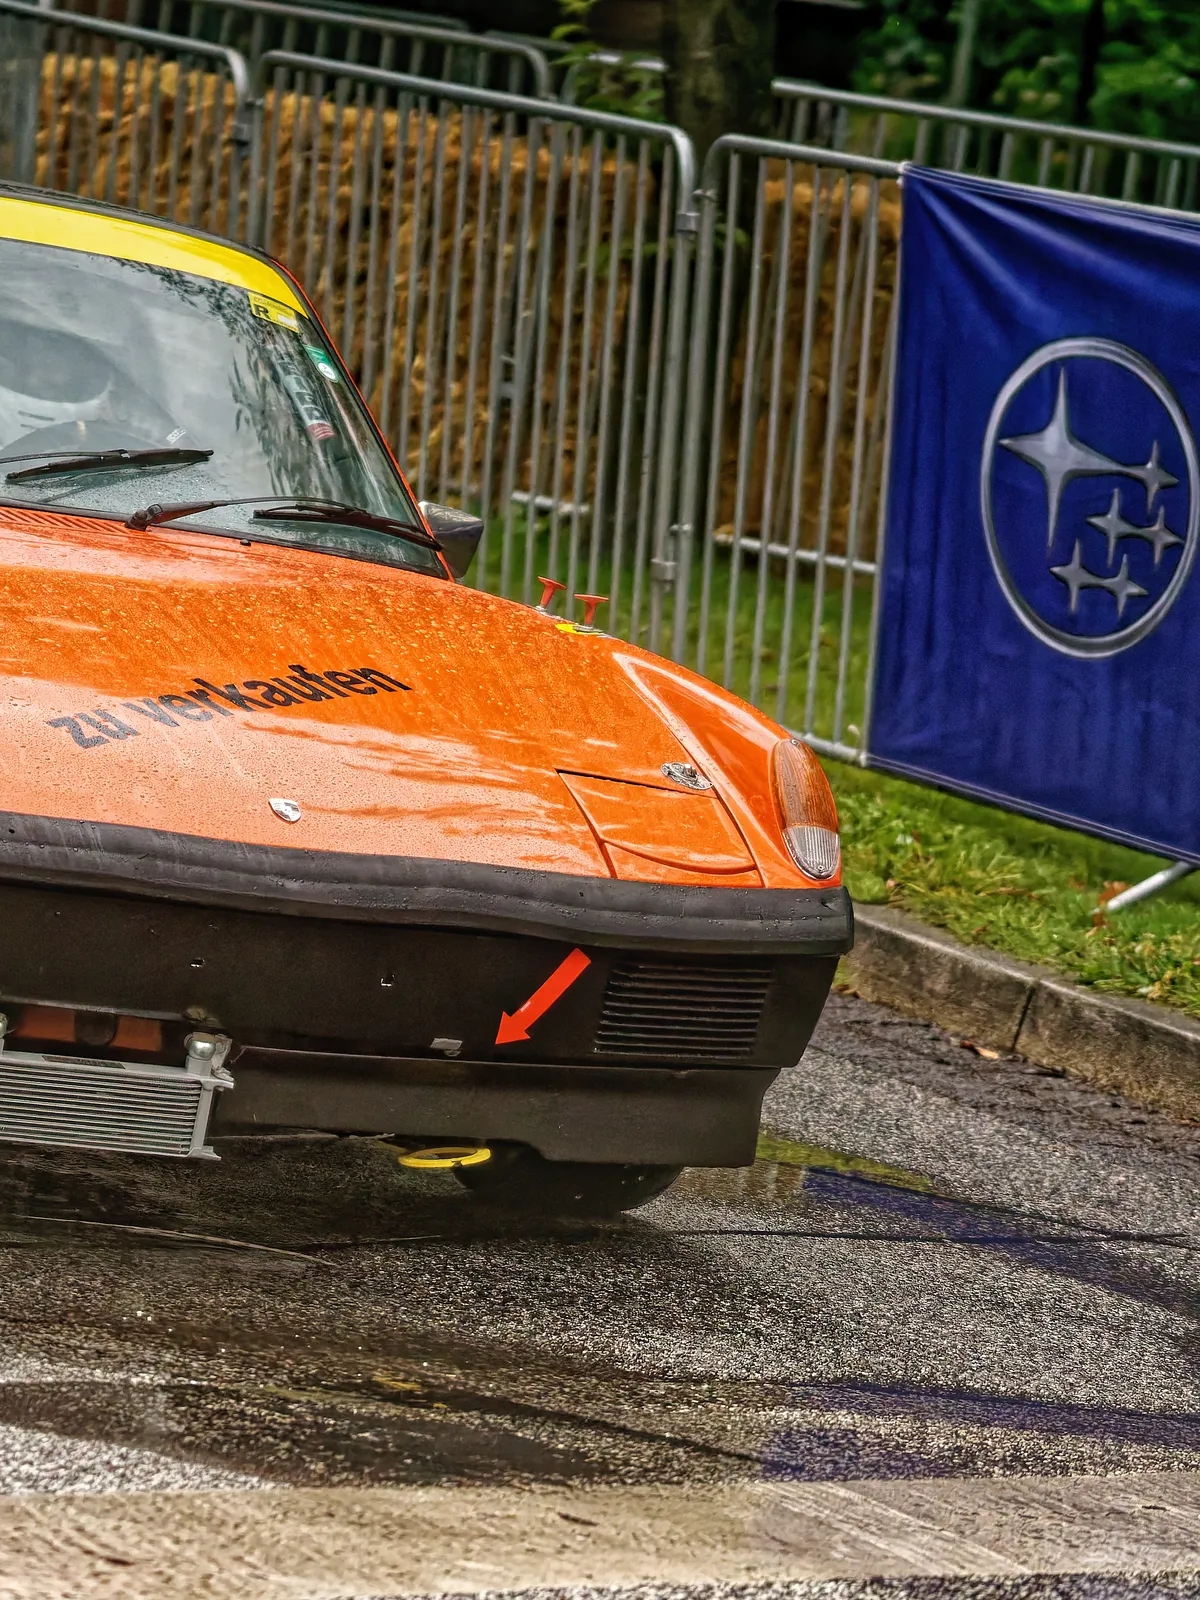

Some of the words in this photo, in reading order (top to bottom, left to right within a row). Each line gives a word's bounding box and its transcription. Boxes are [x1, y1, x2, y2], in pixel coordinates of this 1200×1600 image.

[254, 303, 272, 320] R
[46, 708, 142, 750] zu
[122, 664, 413, 728] verkaufen
